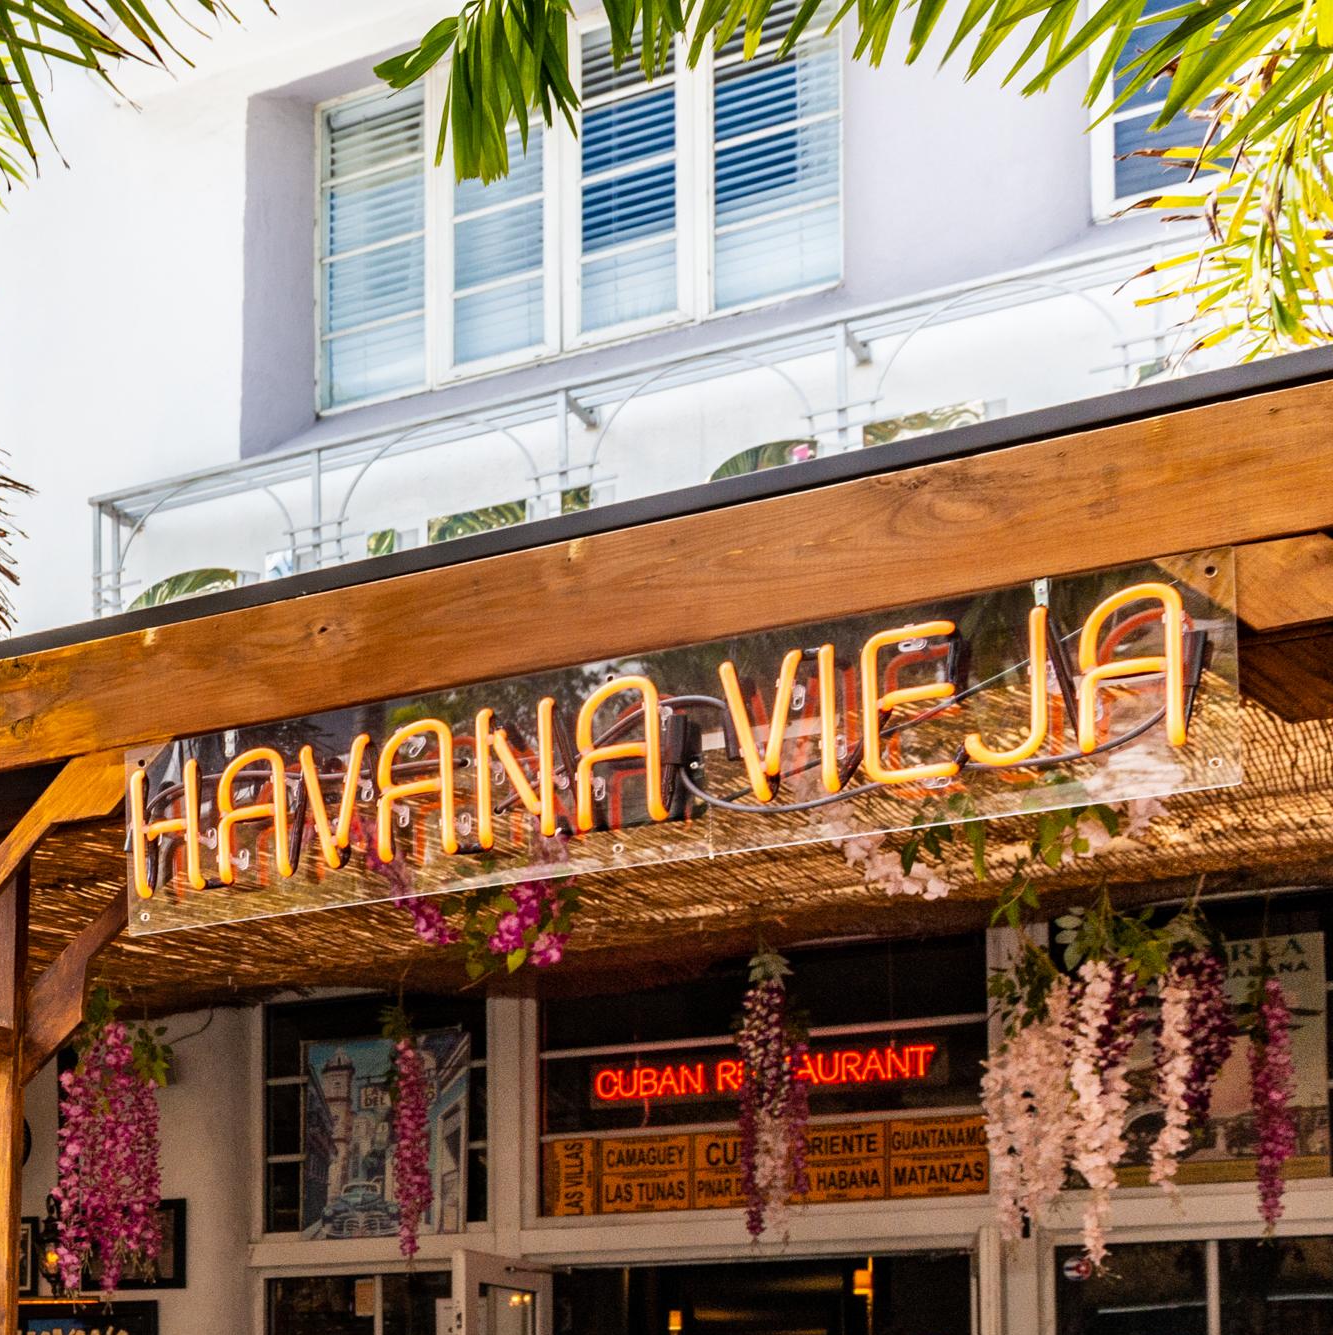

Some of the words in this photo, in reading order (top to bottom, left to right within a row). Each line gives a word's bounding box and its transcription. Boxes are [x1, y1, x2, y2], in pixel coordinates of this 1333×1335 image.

[129, 675, 672, 900] HAVANA
[718, 582, 1186, 802] VIEJA
[595, 1062, 703, 1101] CUBAN
[717, 1044, 935, 1090] RAURANT
[565, 1143, 584, 1189] VILLAS
[608, 1146, 684, 1167] CAMAGUEY
[818, 1169, 880, 1190] HABANA
[895, 1161, 984, 1185] MATANZAS
[605, 1183, 632, 1203] LAS
[638, 1181, 685, 1201] TUNAS
[697, 1179, 733, 1197] PINAR
